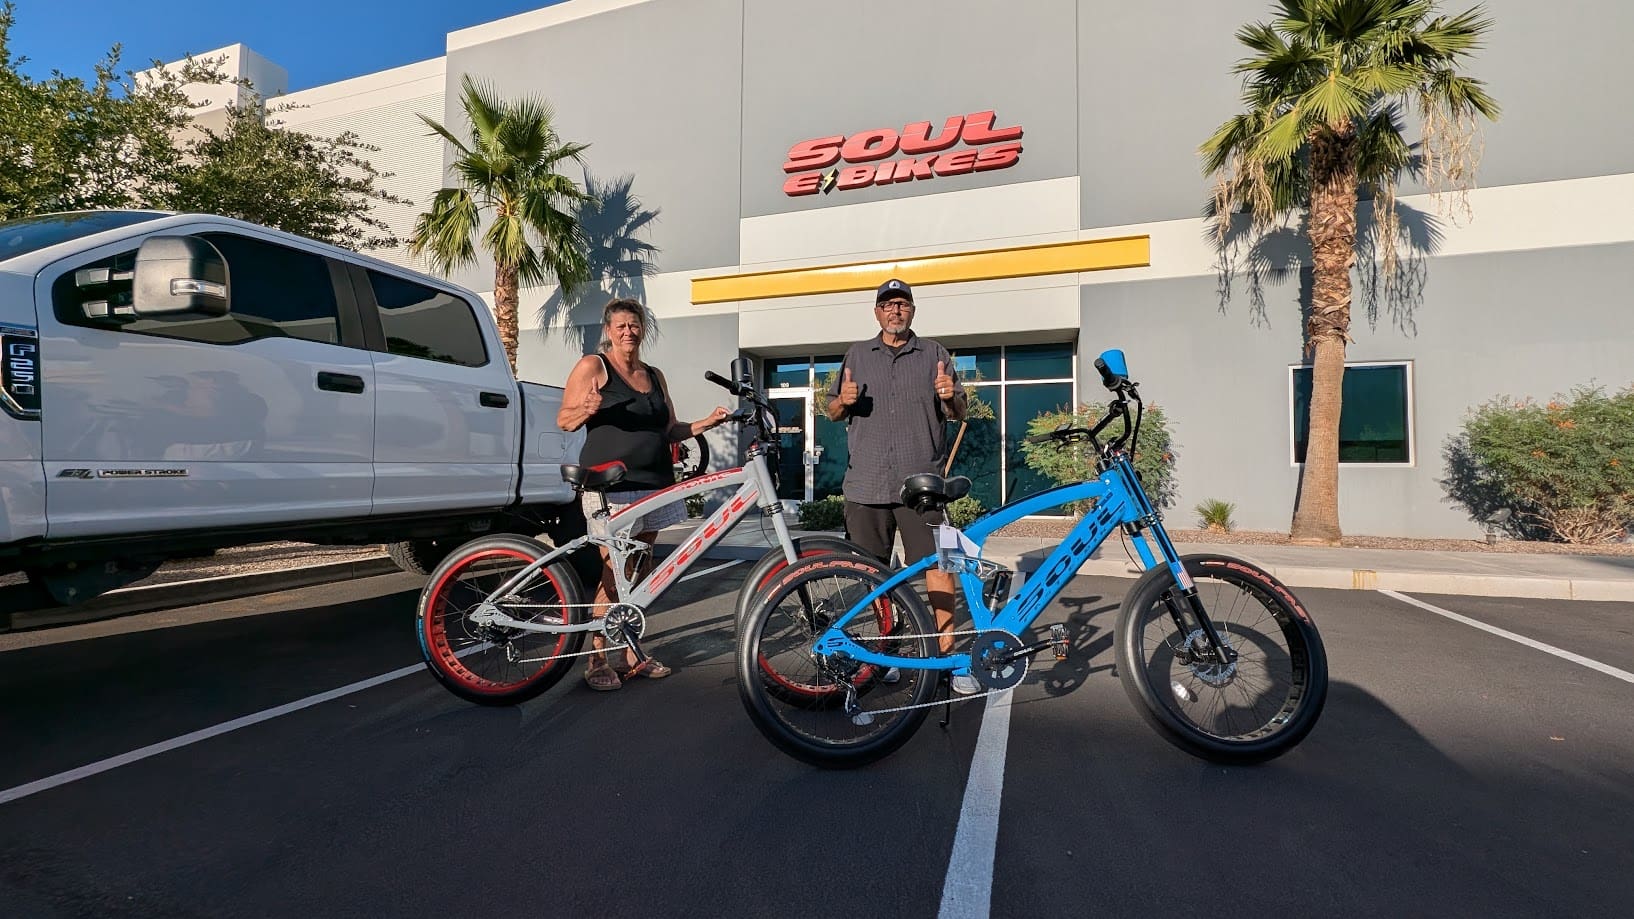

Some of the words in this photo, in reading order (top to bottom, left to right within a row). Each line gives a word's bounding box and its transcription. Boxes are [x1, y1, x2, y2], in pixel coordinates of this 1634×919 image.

[783, 110, 1023, 173] SOUL
[649, 490, 758, 594] SOUL
[782, 561, 829, 586] SOUL
[829, 560, 880, 574] FAST
[1017, 501, 1125, 622] SOUL
[1226, 562, 1275, 588] SOUL
